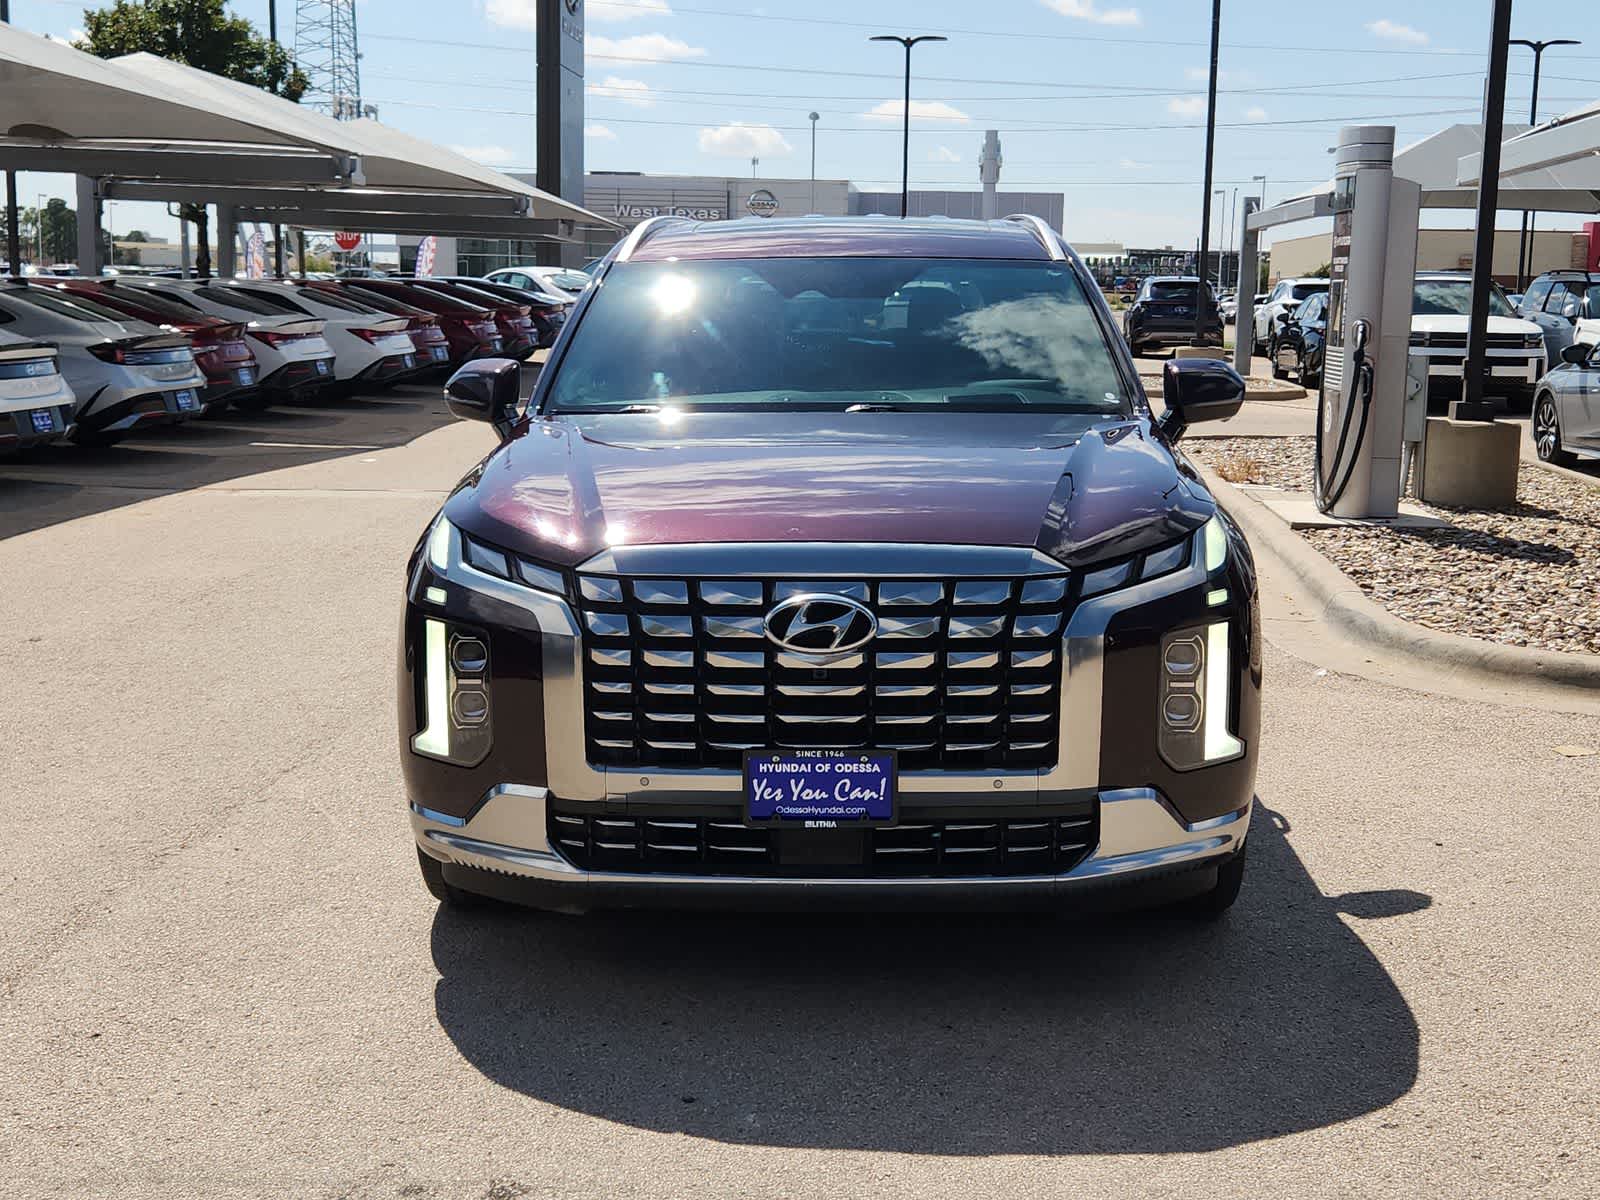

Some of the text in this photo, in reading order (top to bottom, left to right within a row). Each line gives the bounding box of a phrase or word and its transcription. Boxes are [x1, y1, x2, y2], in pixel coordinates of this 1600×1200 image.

[614, 205, 721, 220] West Texas
[336, 232, 360, 241] STOP
[796, 750, 845, 758] SINCE 1946
[759, 763, 881, 773] HYUNDAI OF ODESSA
[752, 777, 887, 802] Yes You Can!
[775, 805, 866, 815] OdessaHyundai.com
[812, 820, 837, 828] LITHIA
